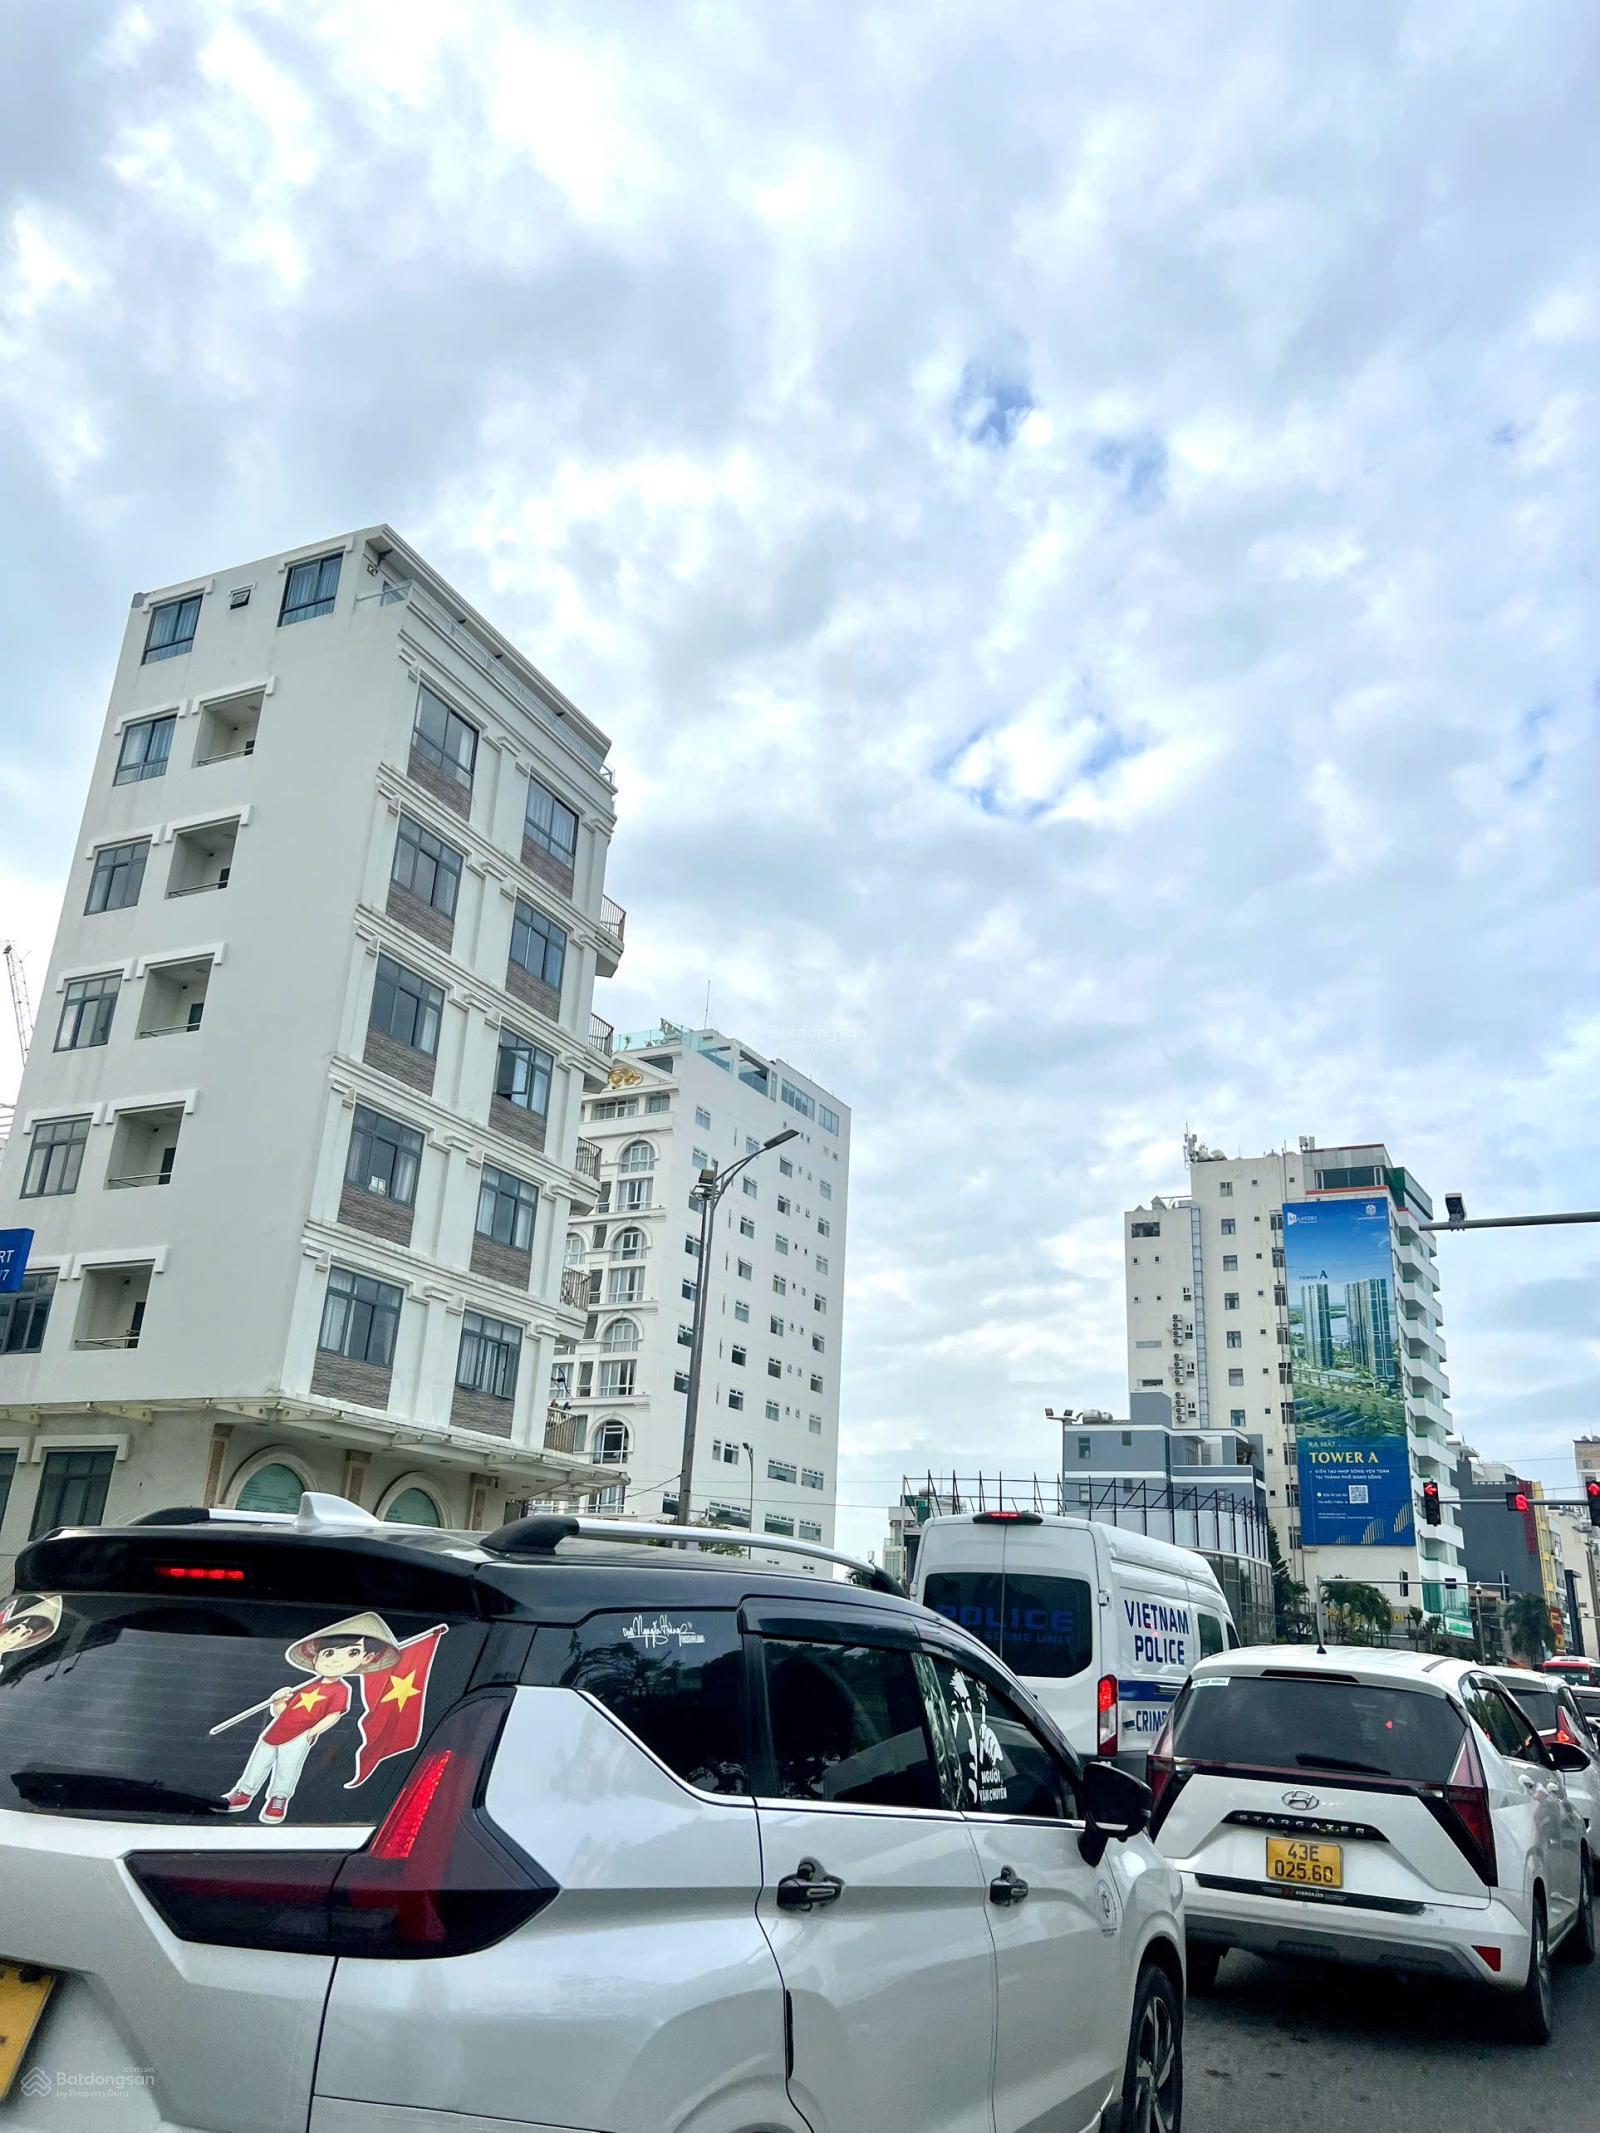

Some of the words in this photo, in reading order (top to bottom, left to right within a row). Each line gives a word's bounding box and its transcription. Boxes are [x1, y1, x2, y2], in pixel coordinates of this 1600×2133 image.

[1320, 1269, 1329, 1280] A
[1309, 1452, 1365, 1464] TOWER
[1368, 1452, 1379, 1464] A
[1124, 1599, 1190, 1635] VIETNAM
[1135, 1635, 1186, 1665] POLICE
[1239, 1814, 1365, 1833] STARGAZER
[1287, 1844, 1320, 1863] 43E
[1274, 1861, 1334, 1884] 025.60
